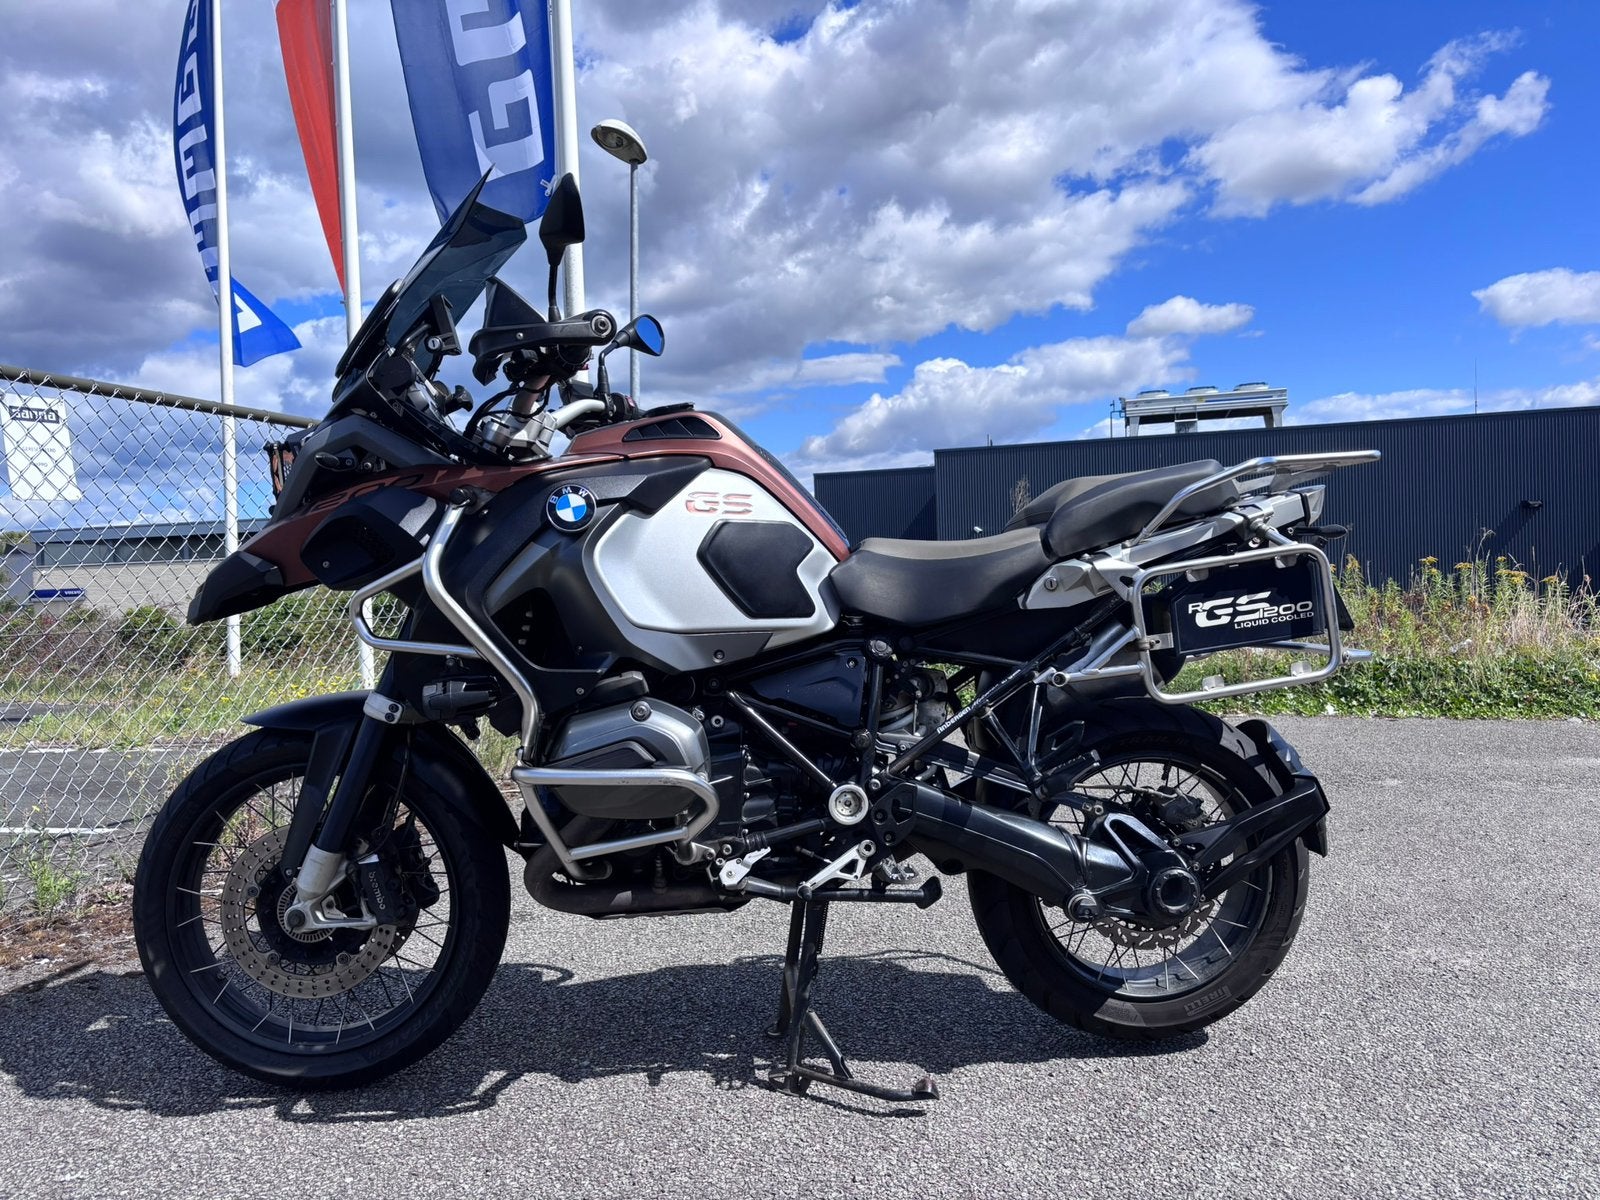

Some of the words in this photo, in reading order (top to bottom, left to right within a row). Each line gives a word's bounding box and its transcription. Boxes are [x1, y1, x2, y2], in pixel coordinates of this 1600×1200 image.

[550, 486, 588, 504] BMW
[685, 491, 753, 515] GS
[1234, 618, 1269, 629] LIQUID
[1271, 611, 1315, 624] COOLED
[368, 870, 386, 910] brembo
[1183, 985, 1232, 1017] PIRELLI
